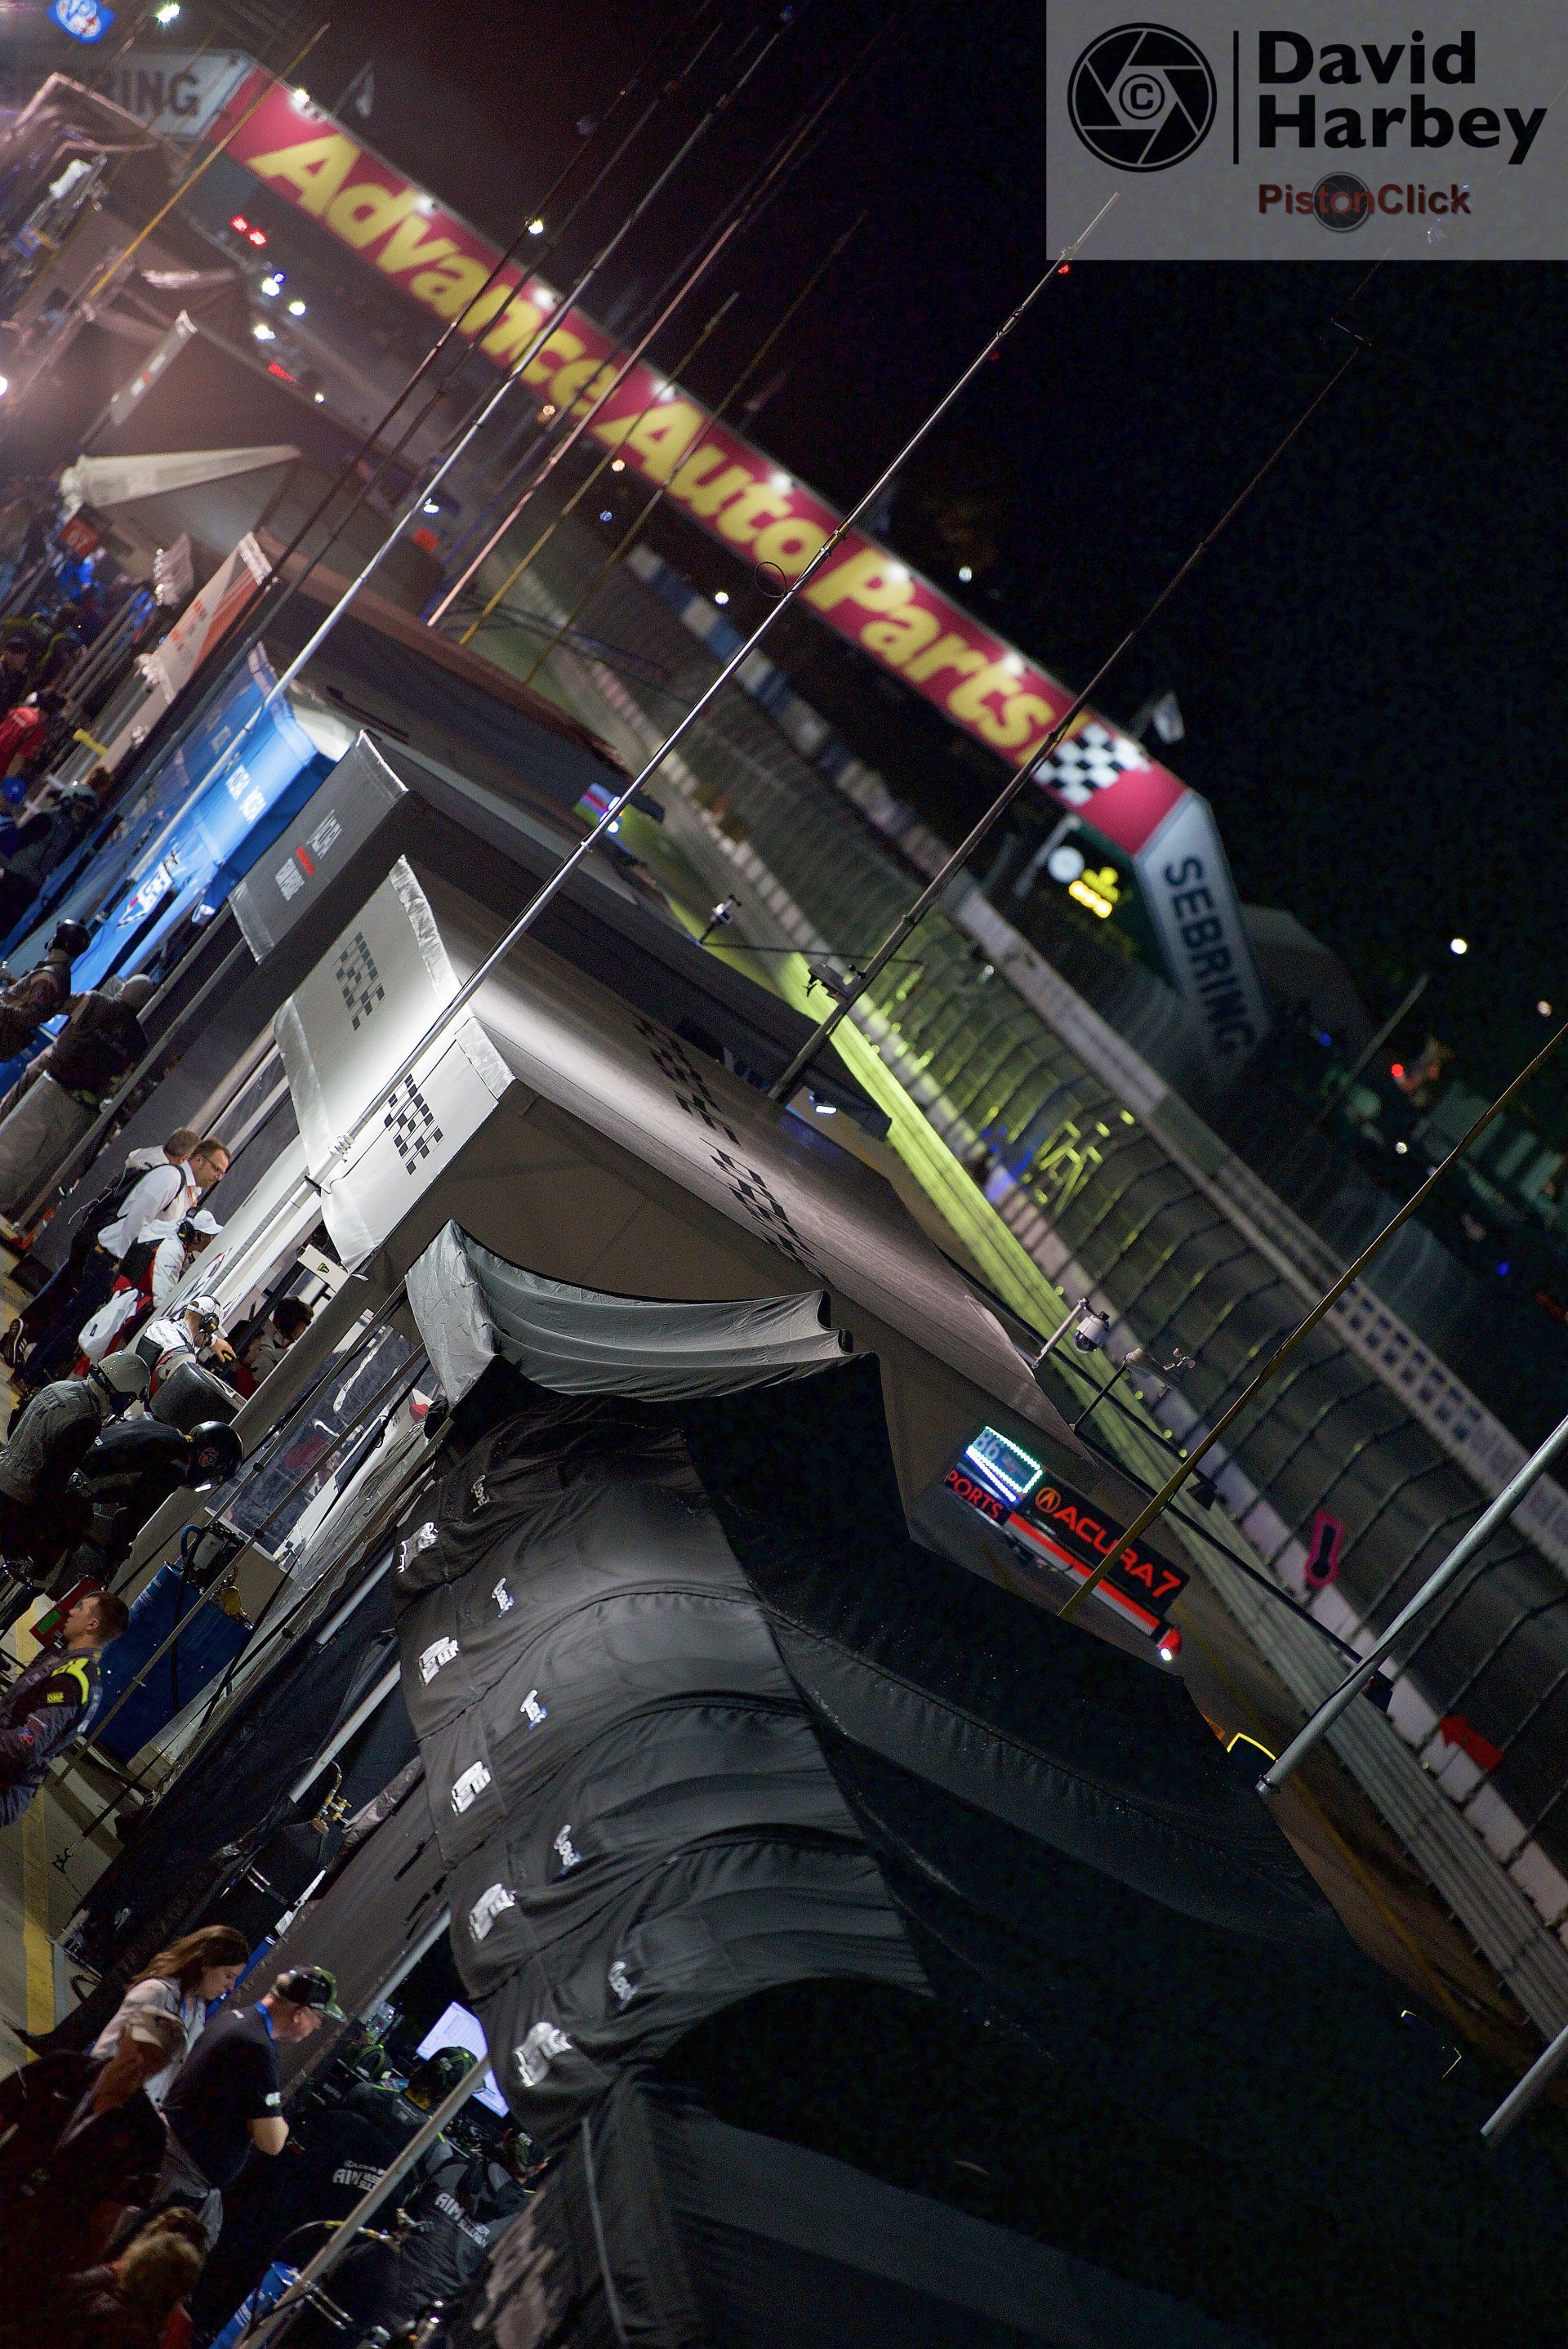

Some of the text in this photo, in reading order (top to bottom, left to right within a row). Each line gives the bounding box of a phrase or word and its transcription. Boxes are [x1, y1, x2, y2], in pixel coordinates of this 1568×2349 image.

[246, 133, 1054, 747] Advance Auto Parts
[1164, 857, 1257, 1054] SEBRING
[1053, 1505, 1182, 1598] ACURA 7
